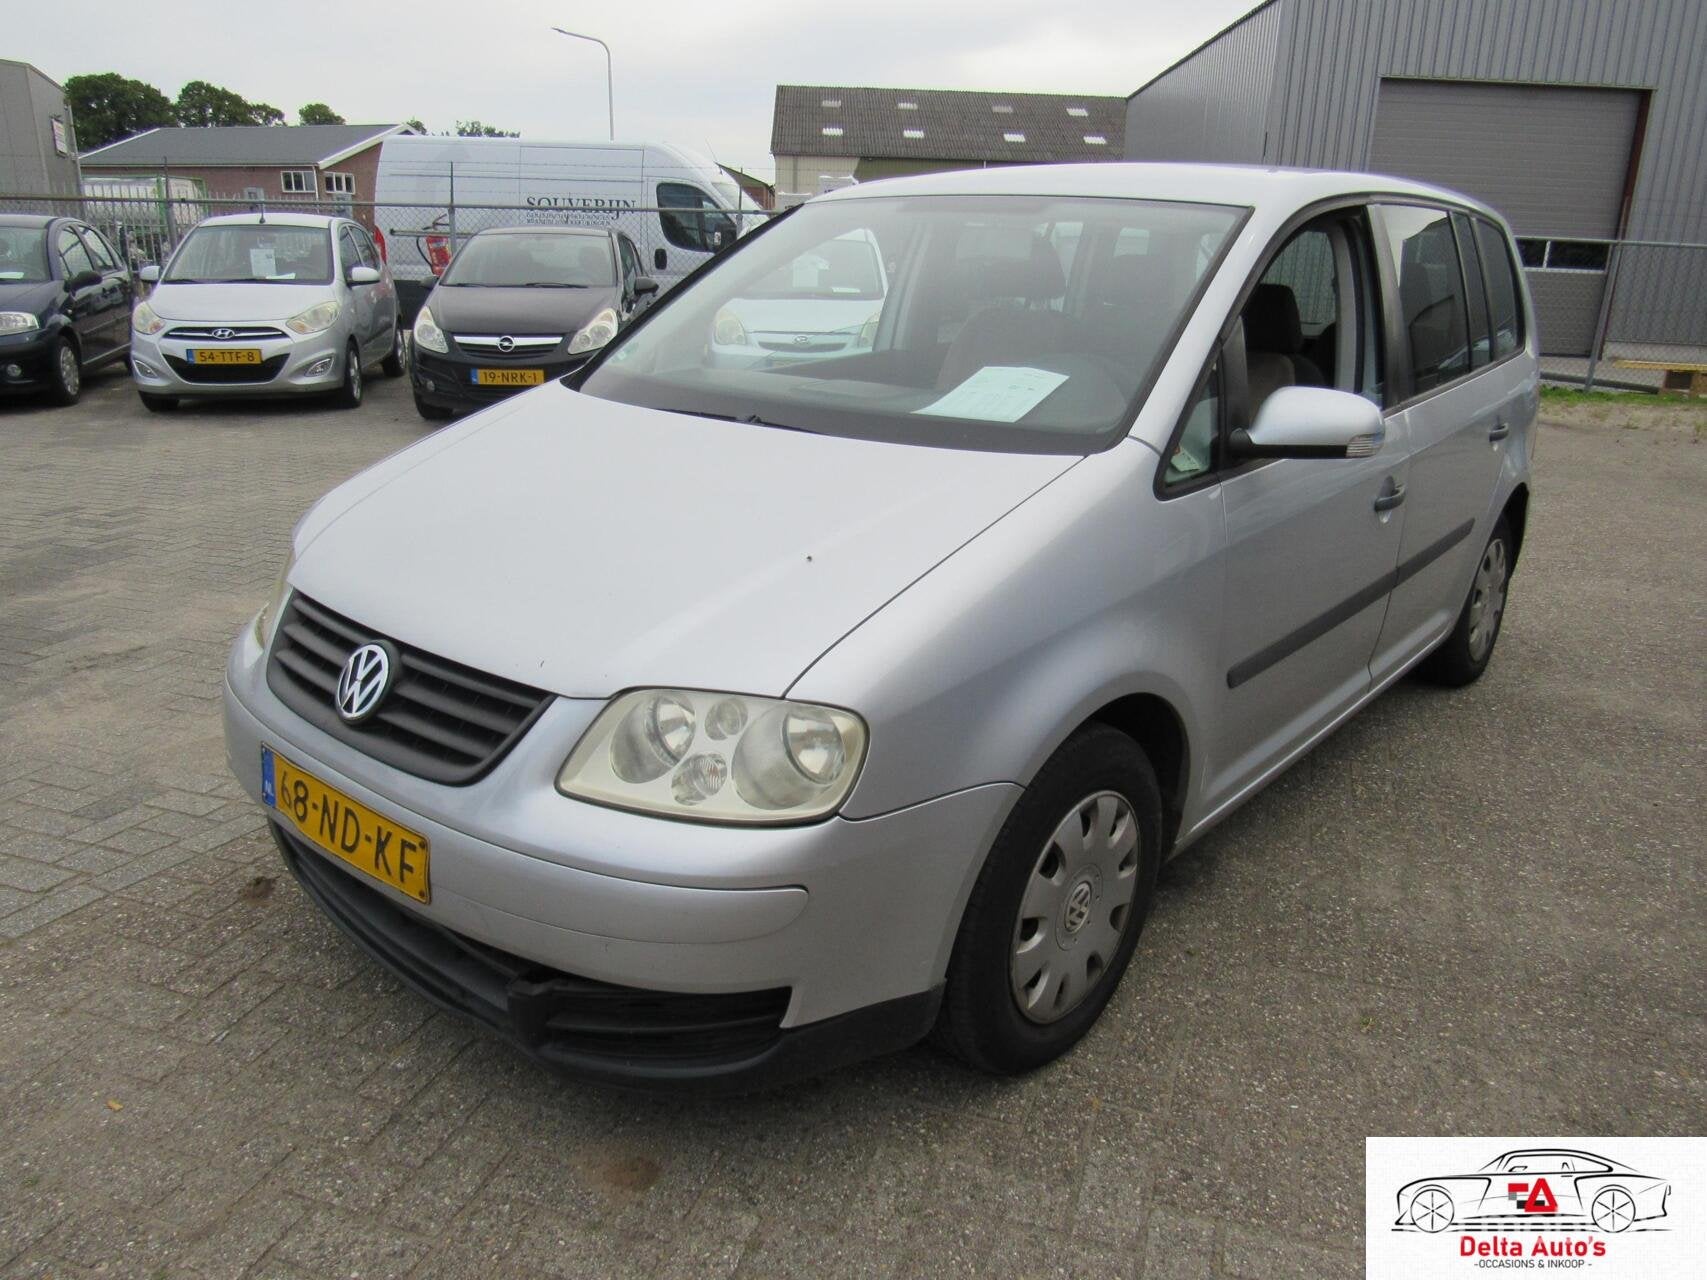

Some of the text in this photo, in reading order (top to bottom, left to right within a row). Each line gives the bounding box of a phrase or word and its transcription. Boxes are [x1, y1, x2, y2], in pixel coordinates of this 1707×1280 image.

[199, 351, 255, 361] 54-TTF-8
[483, 371, 537, 384] 19-NRK-1
[280, 771, 417, 884] 68-ND-KF
